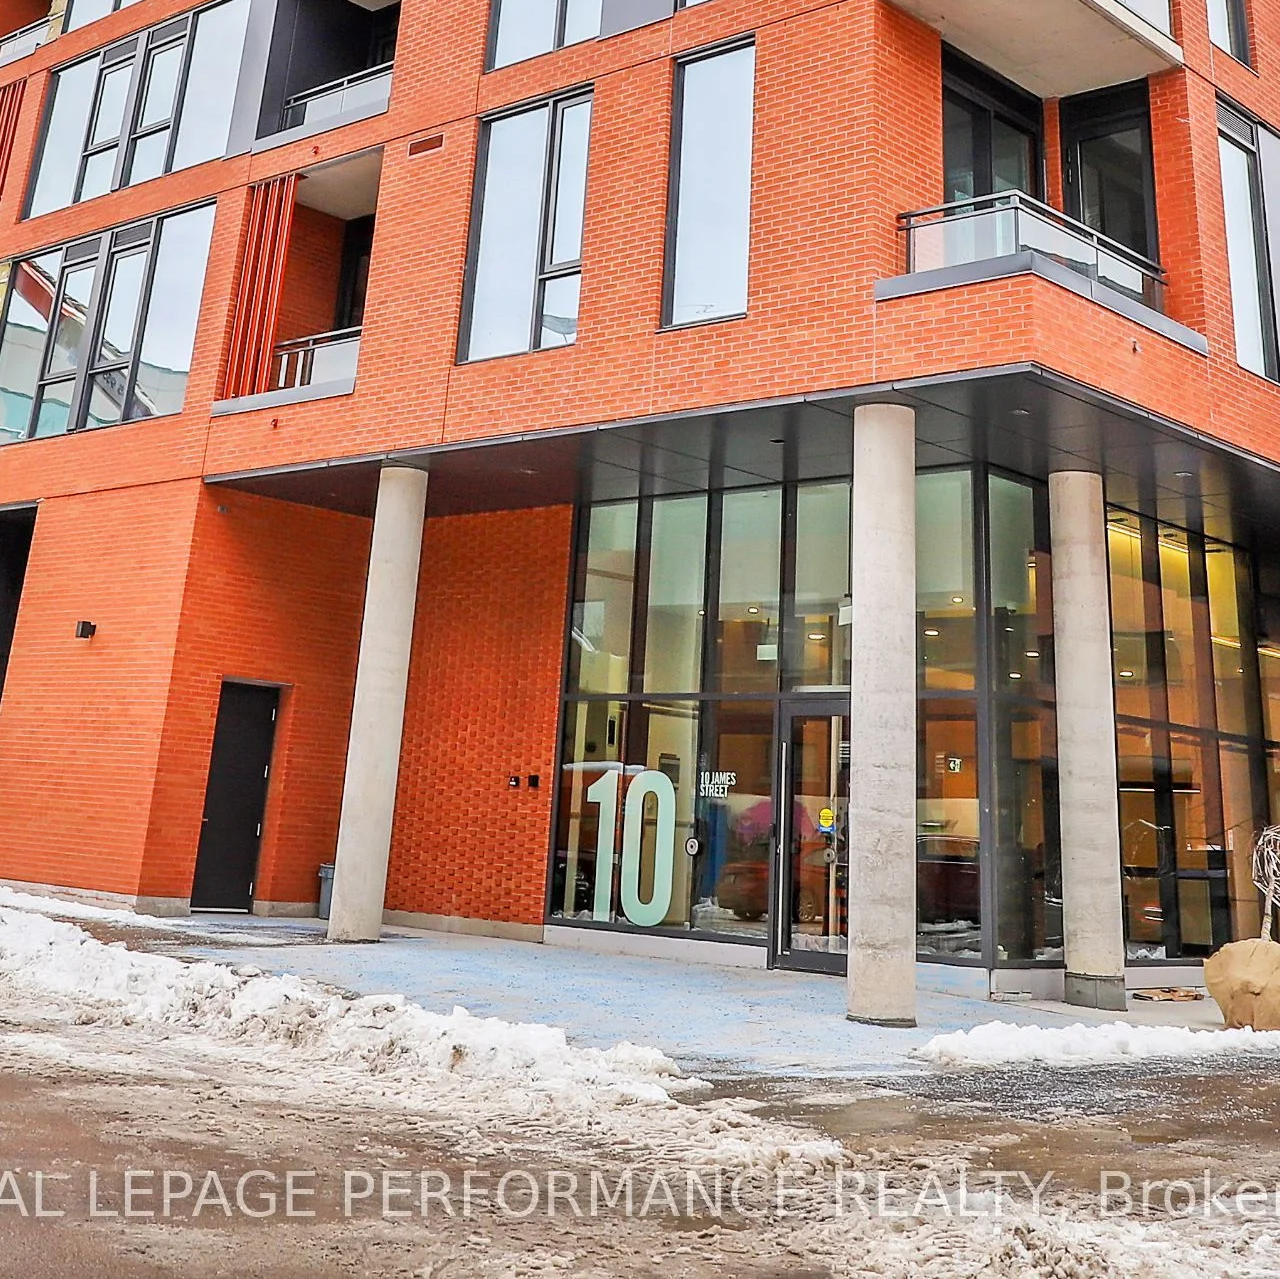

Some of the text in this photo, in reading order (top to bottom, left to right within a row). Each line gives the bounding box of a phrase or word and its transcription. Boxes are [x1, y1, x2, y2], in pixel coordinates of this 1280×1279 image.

[700, 771, 736, 786] 10 JAMES
[700, 784, 729, 798] STREET
[587, 770, 676, 927] 10
